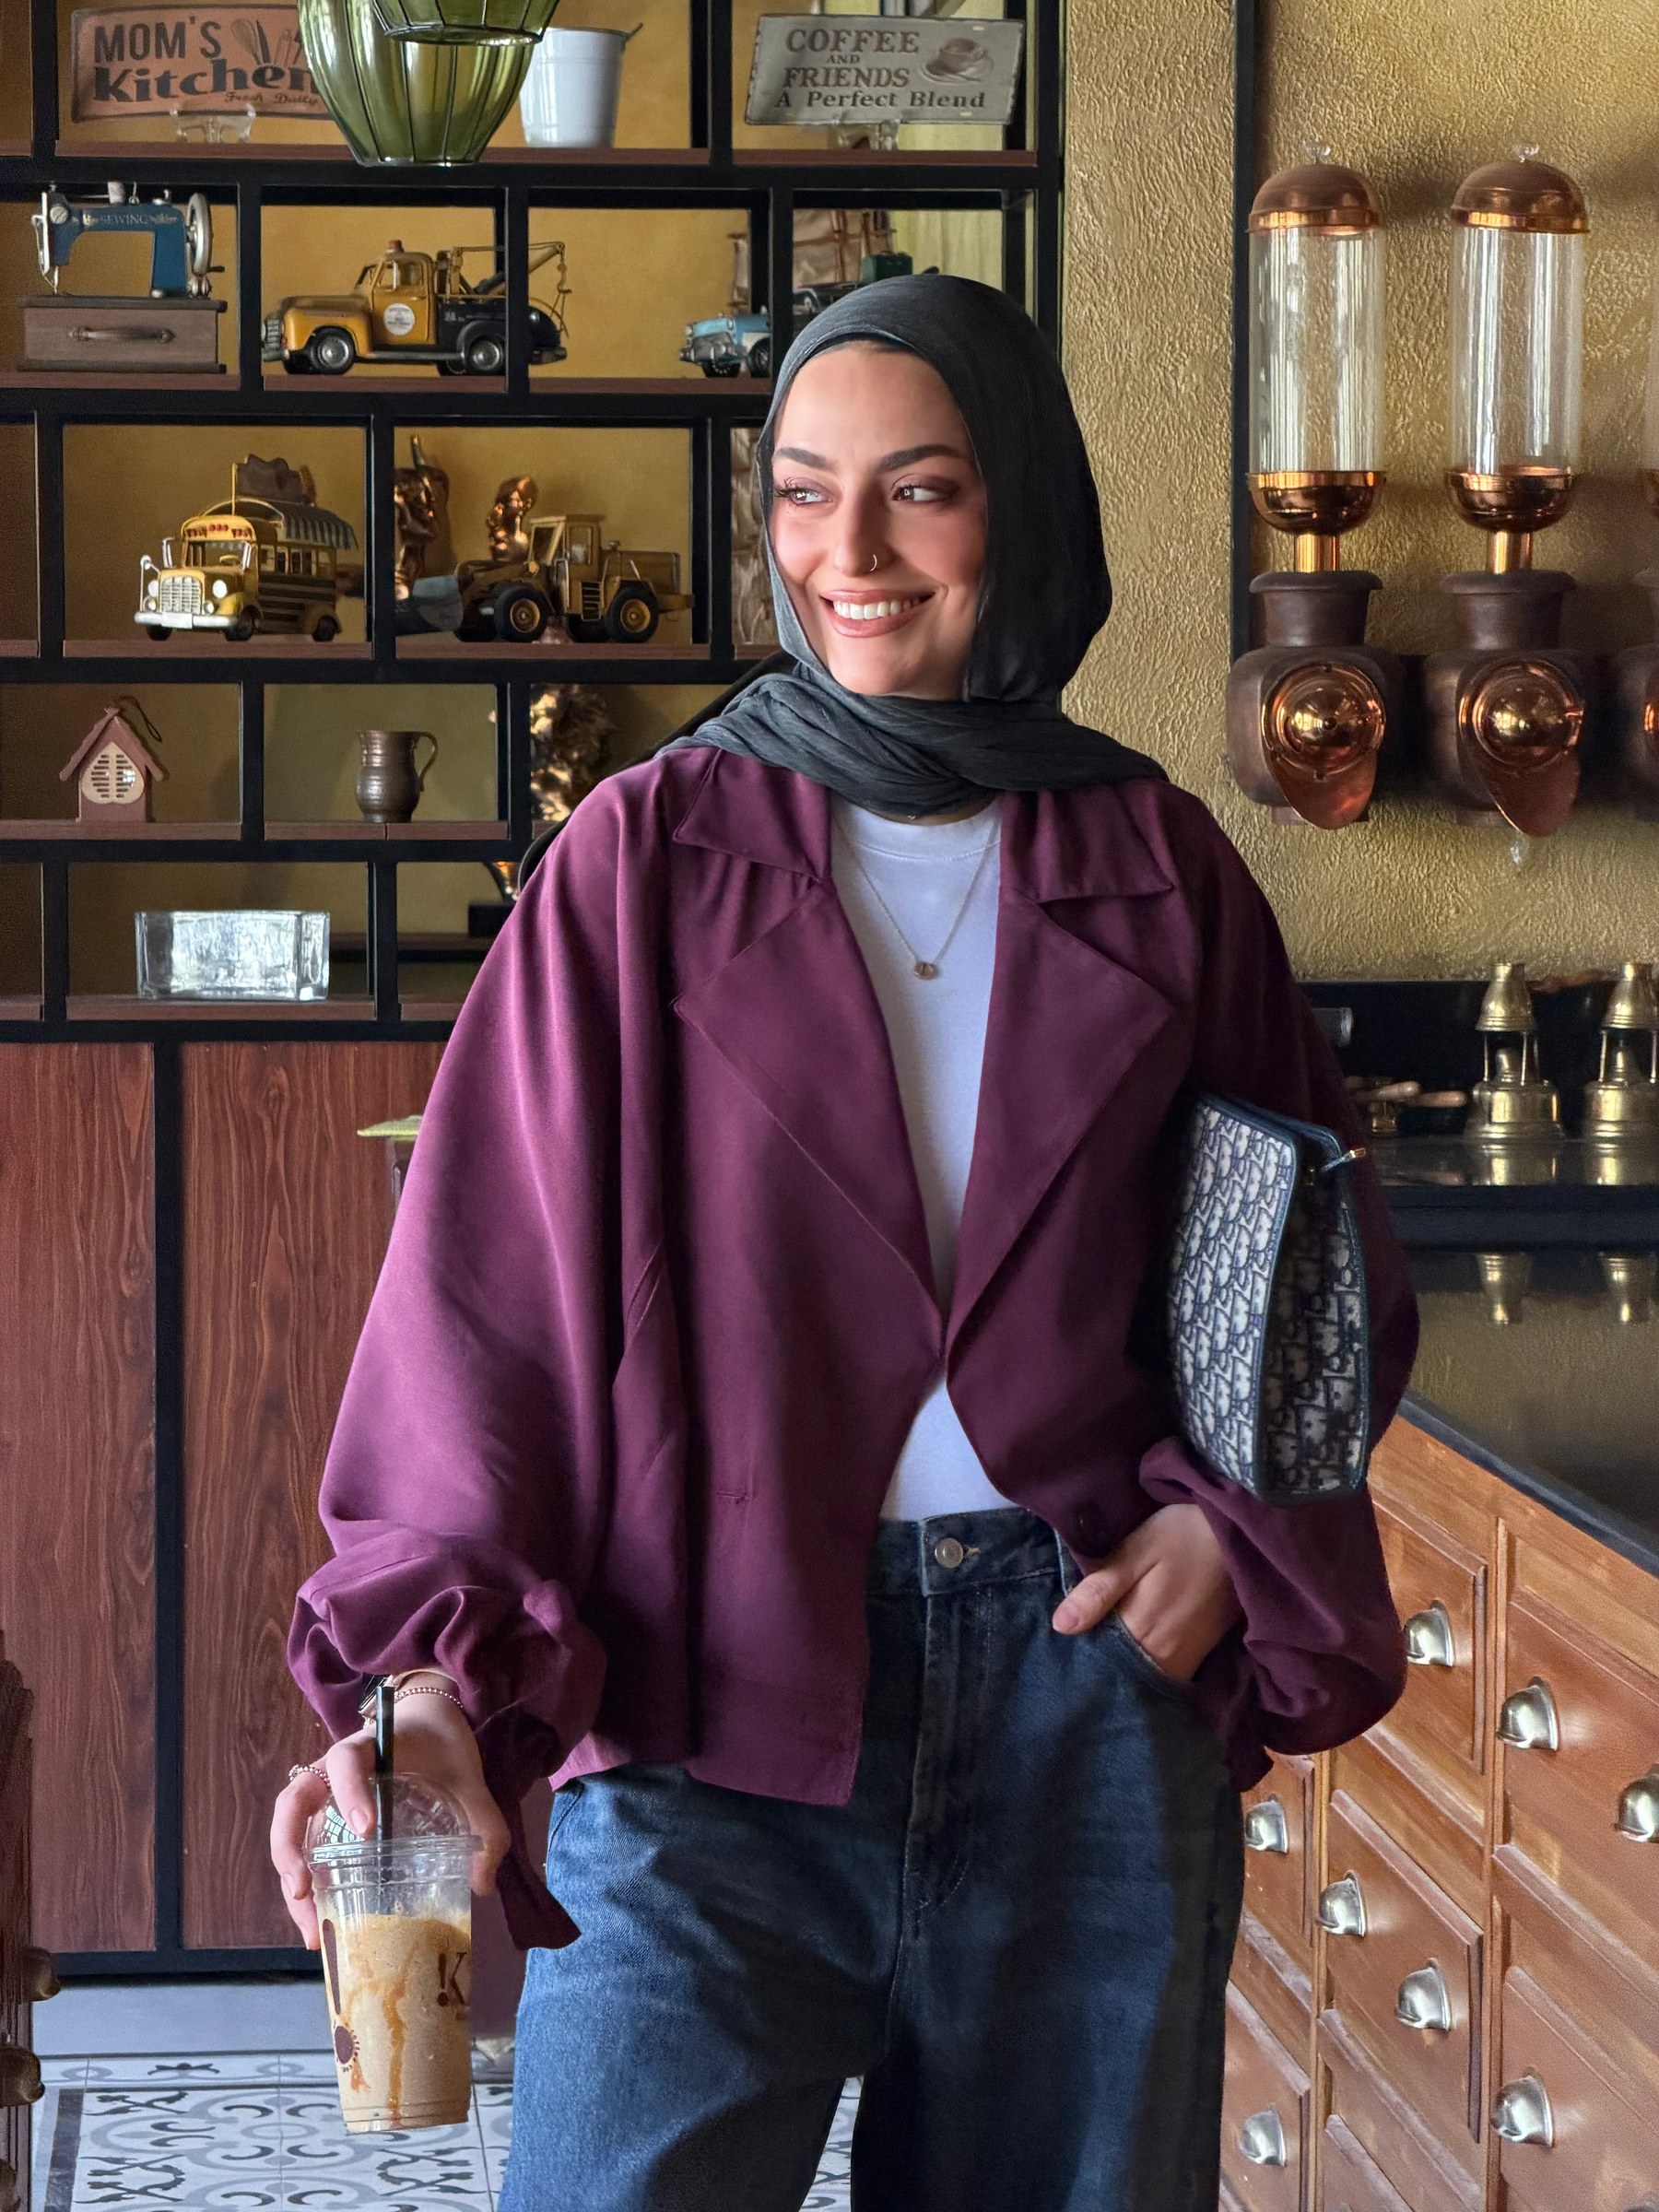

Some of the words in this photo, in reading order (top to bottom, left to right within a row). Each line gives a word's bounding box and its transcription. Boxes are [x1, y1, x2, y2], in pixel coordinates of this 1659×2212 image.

[94, 16, 221, 63] MOM'S
[786, 29, 920, 53] COFFEE
[827, 54, 860, 65] AND
[782, 67, 911, 88] FRIENDS
[774, 91, 792, 108] A
[807, 90, 898, 108] Perfect
[911, 91, 985, 109] Blend
[100, 213, 149, 225] SEWING
